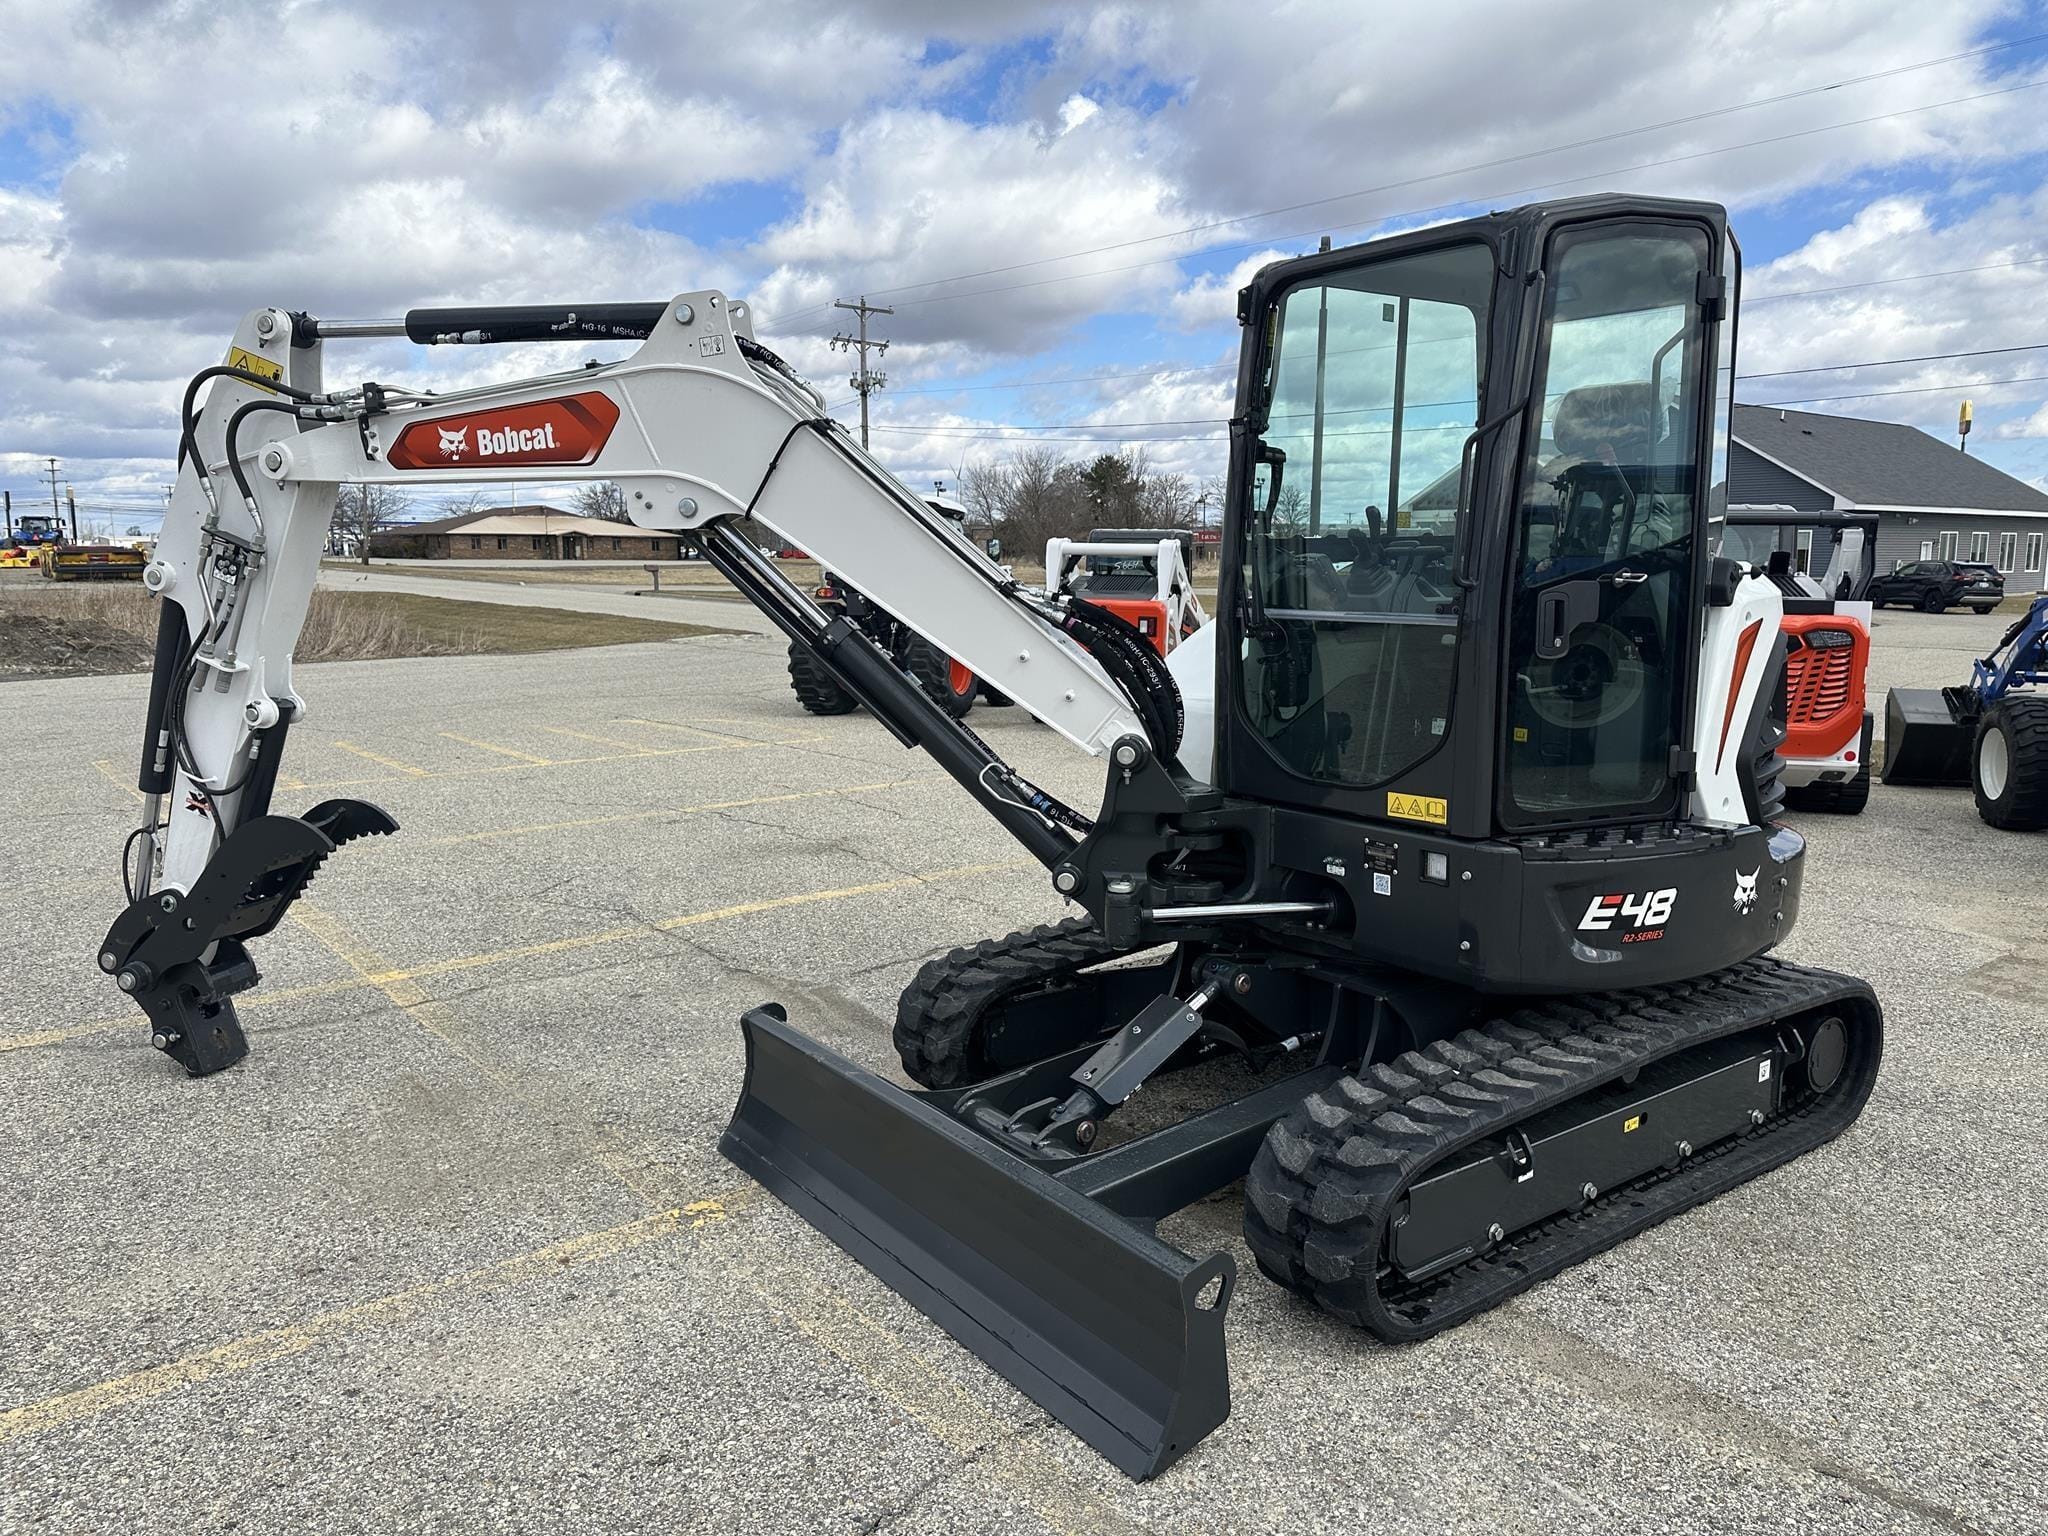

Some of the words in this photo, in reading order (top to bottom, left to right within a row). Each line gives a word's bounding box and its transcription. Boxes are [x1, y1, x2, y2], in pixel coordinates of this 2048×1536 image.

[582, 323, 607, 333] HG-16
[476, 422, 555, 457] Bobcat
[1577, 887, 1678, 930] E48
[1622, 929, 1665, 943] R2-SERIES
